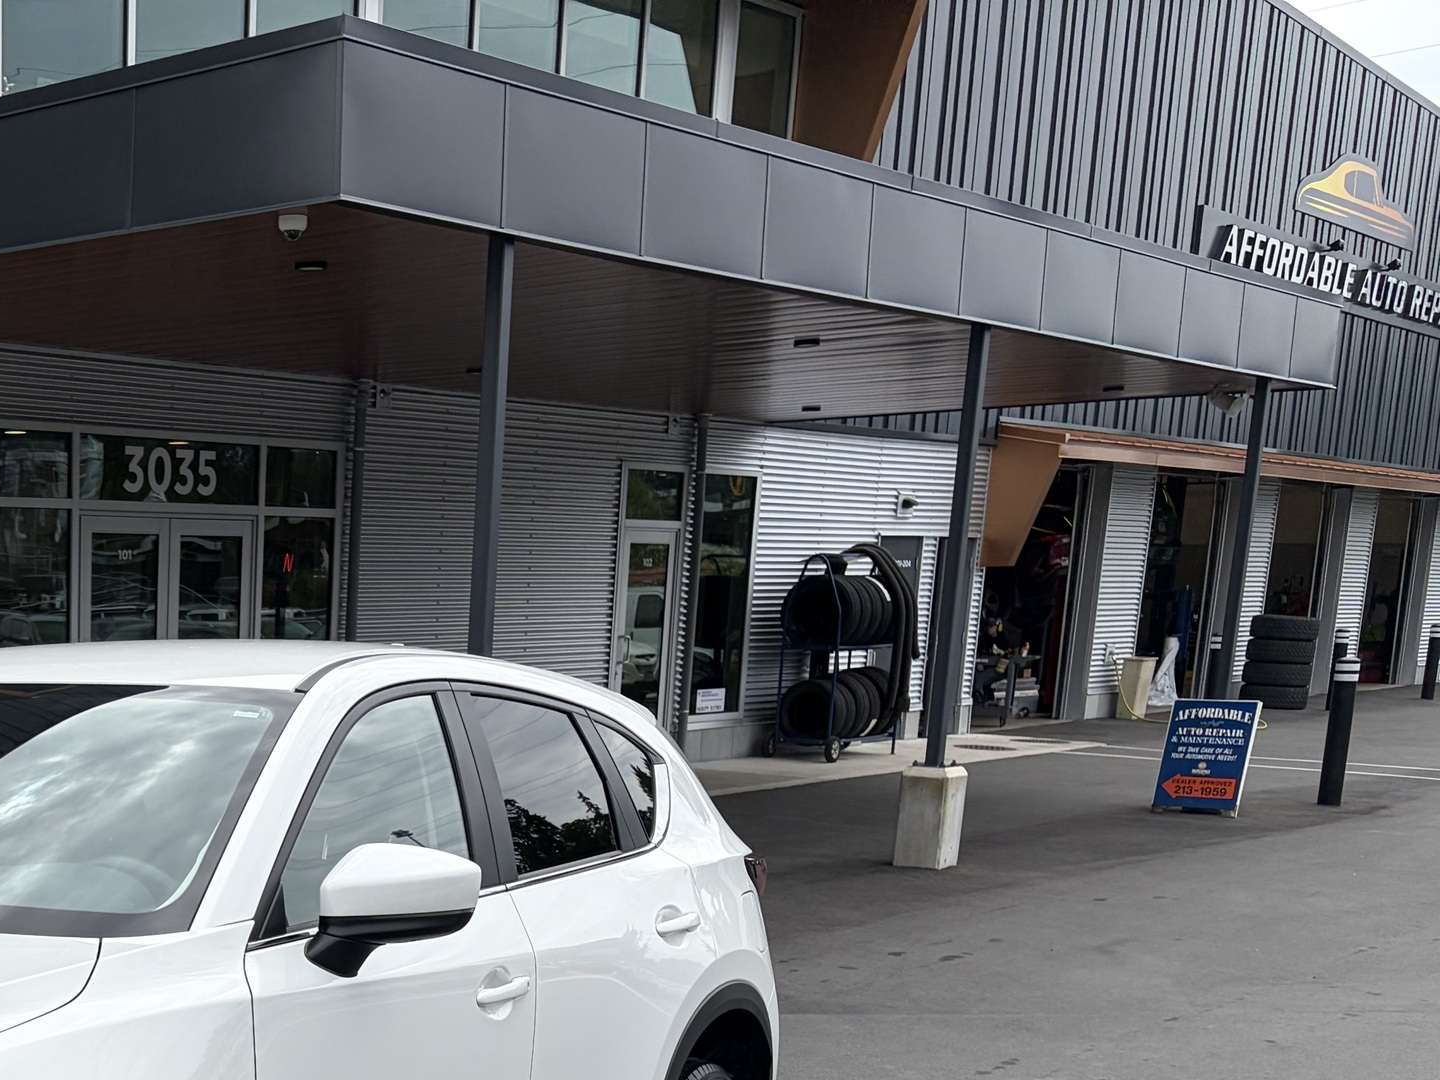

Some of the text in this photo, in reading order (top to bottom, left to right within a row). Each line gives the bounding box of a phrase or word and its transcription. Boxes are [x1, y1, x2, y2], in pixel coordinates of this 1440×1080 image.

[1220, 224, 1440, 325] AFFORDABLE AUTO REP
[122, 445, 217, 496] 3035
[118, 550, 132, 560] 101
[1175, 707, 1252, 724] AFFORDABLE
[1176, 727, 1244, 737] AUTO REPAIR
[1180, 736, 1245, 745] MAINTENANCE
[1174, 785, 1228, 797] 213-1959
